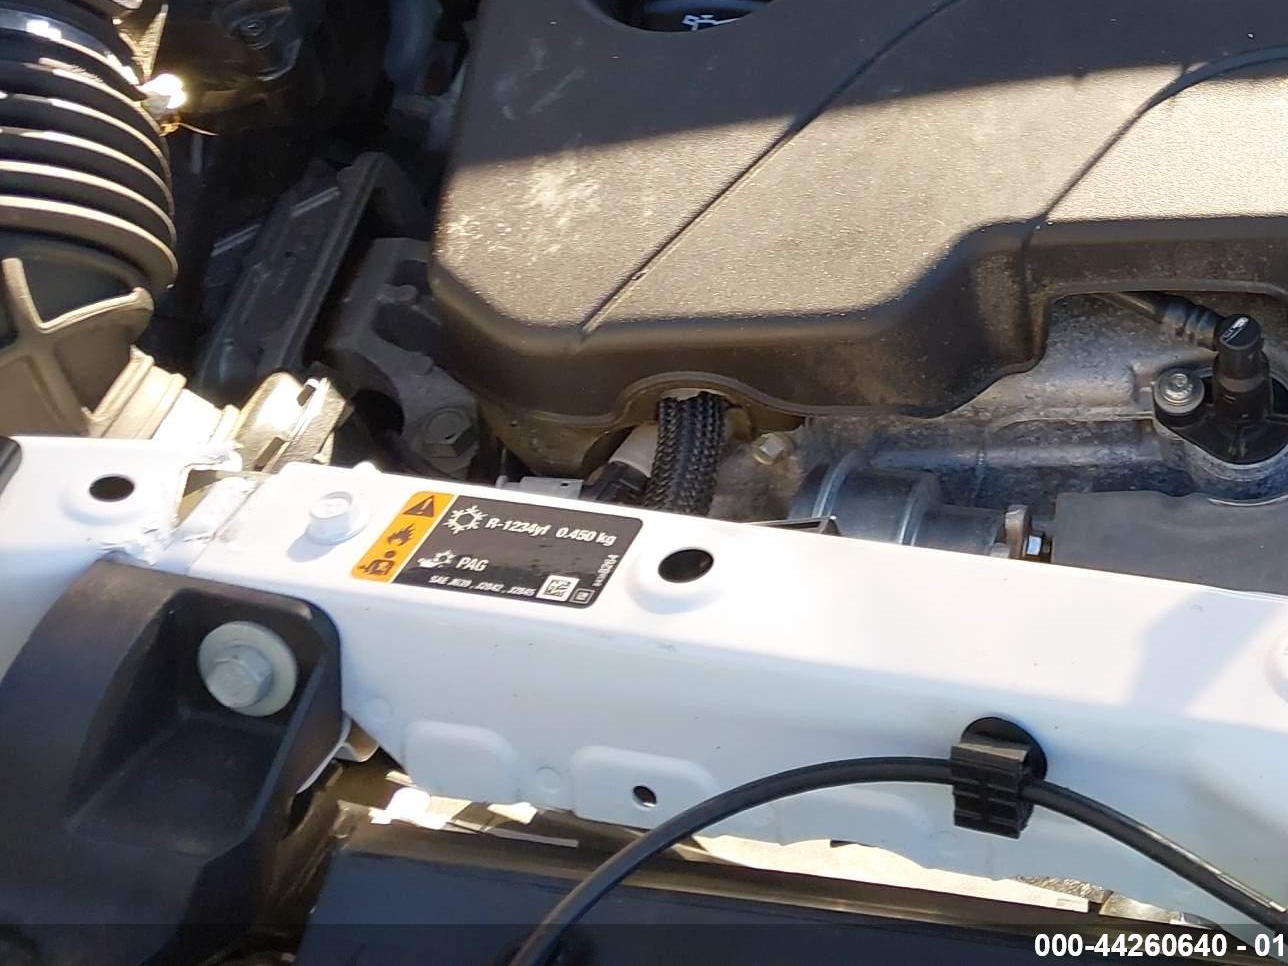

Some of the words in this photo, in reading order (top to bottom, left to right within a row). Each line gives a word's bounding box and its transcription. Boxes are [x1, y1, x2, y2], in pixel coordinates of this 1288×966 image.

[485, 518, 552, 537] R-1234yf
[555, 527, 598, 542] 0.450
[595, 532, 617, 547] kg
[456, 557, 489, 572] PAG
